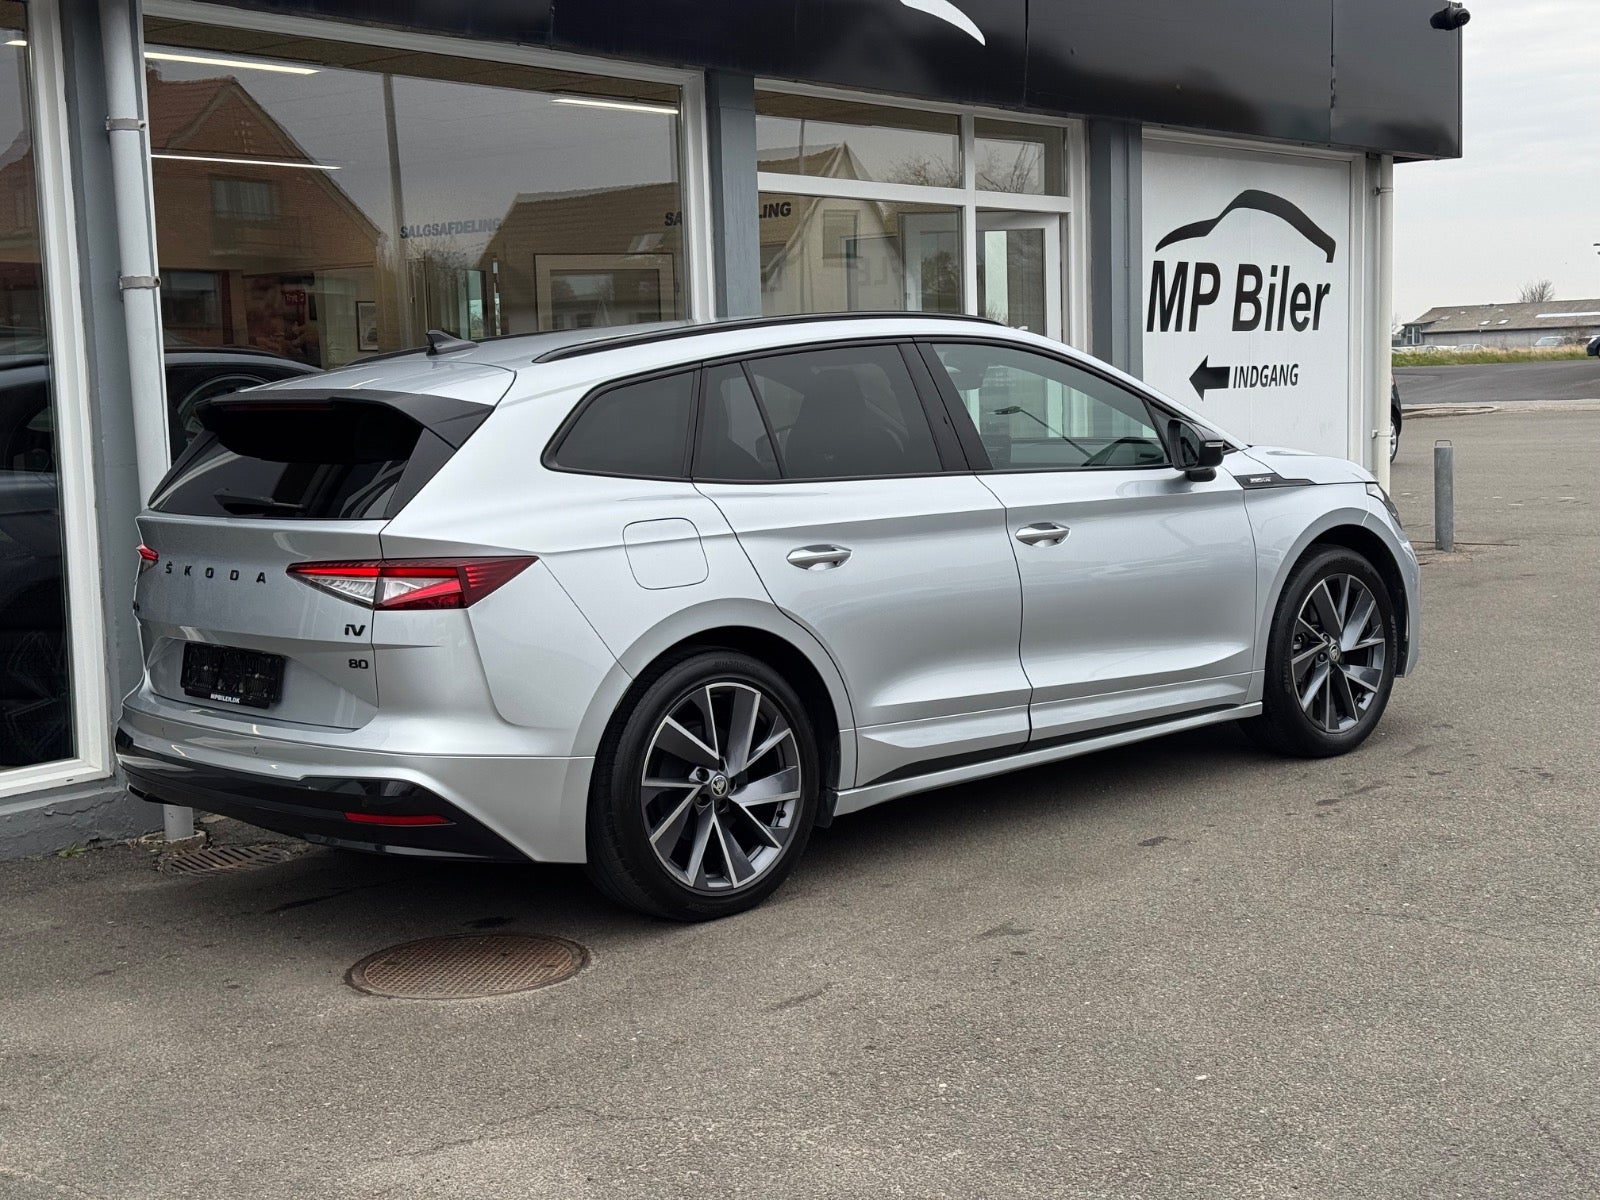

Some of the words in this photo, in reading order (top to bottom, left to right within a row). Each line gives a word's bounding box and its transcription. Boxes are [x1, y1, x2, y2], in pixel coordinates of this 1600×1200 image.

[1146, 260, 1221, 332] MP
[1231, 263, 1331, 332] Biler
[1233, 363, 1299, 389] INDGANG
[165, 560, 267, 584] ŠKODA
[348, 658, 369, 669] 80
